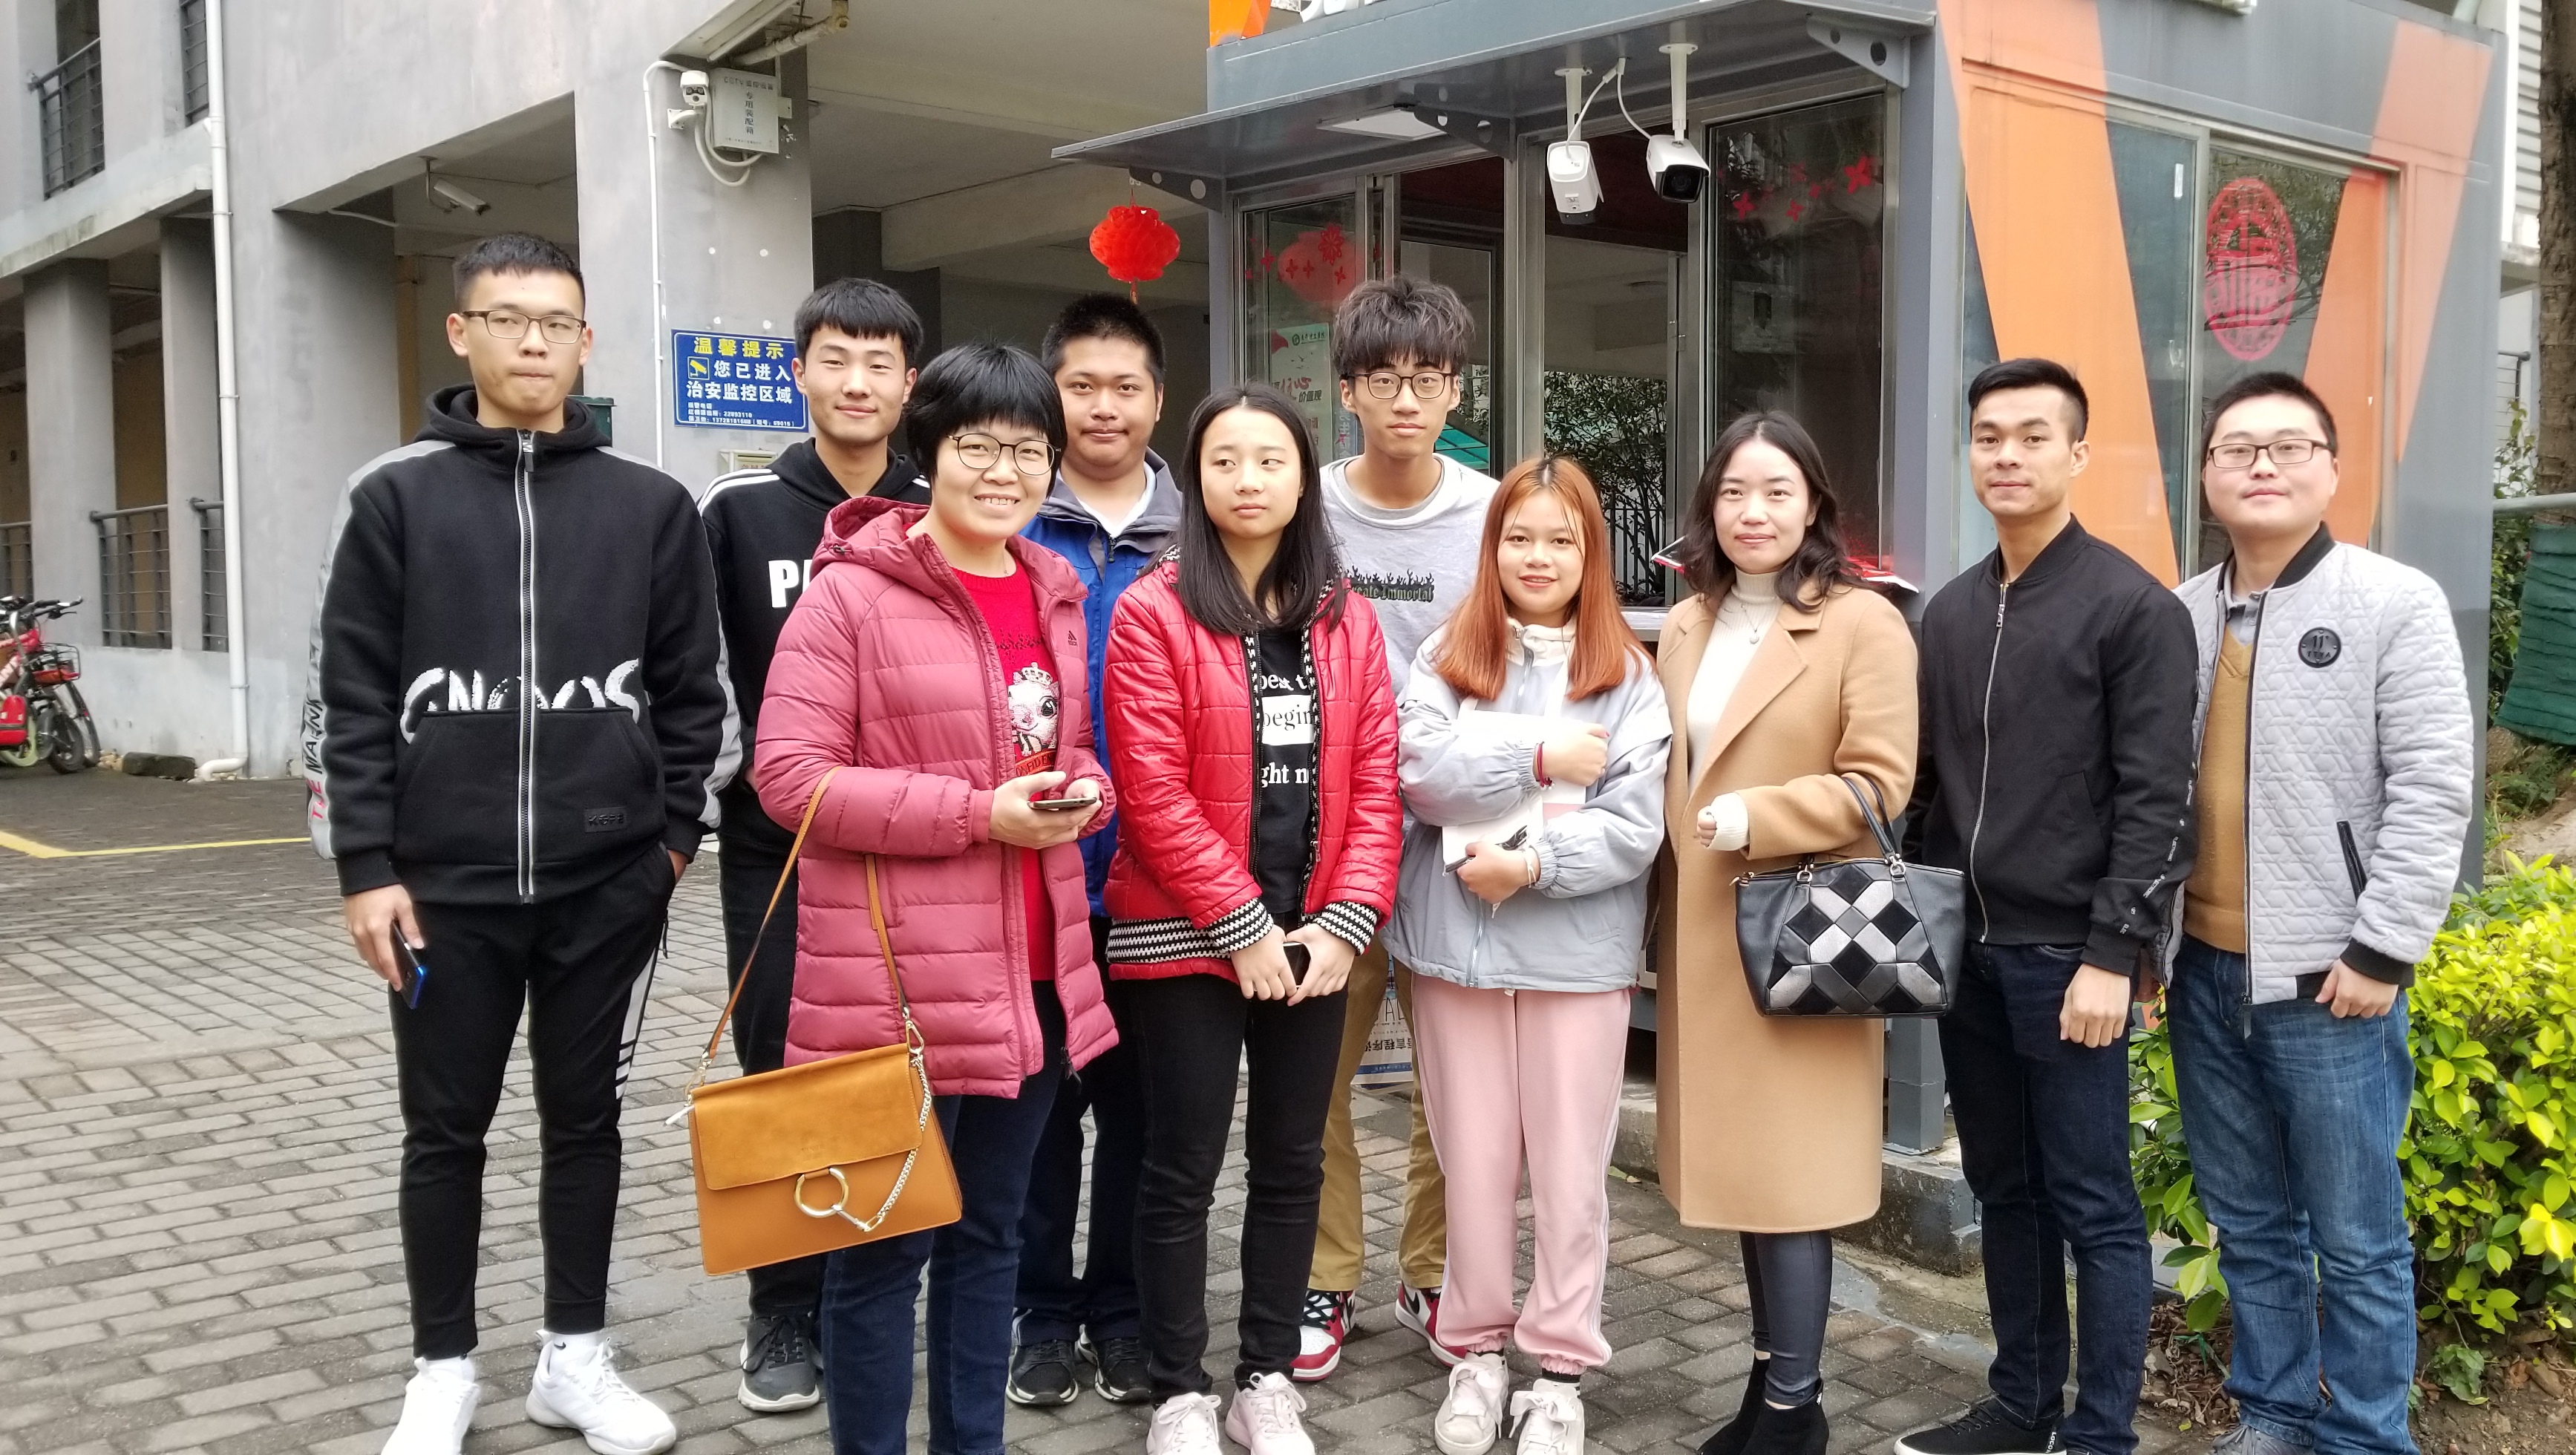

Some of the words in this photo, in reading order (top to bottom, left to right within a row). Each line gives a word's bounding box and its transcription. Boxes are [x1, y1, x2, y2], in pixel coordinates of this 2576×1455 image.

[693, 336, 785, 360] 温馨提示
[713, 360, 791, 382] 您已进入
[686, 381, 793, 405] 治安监控区域
[1298, 390, 1322, 403] 价值观
[1382, 586, 1434, 602] Immortal
[1261, 762, 1289, 788] ght
